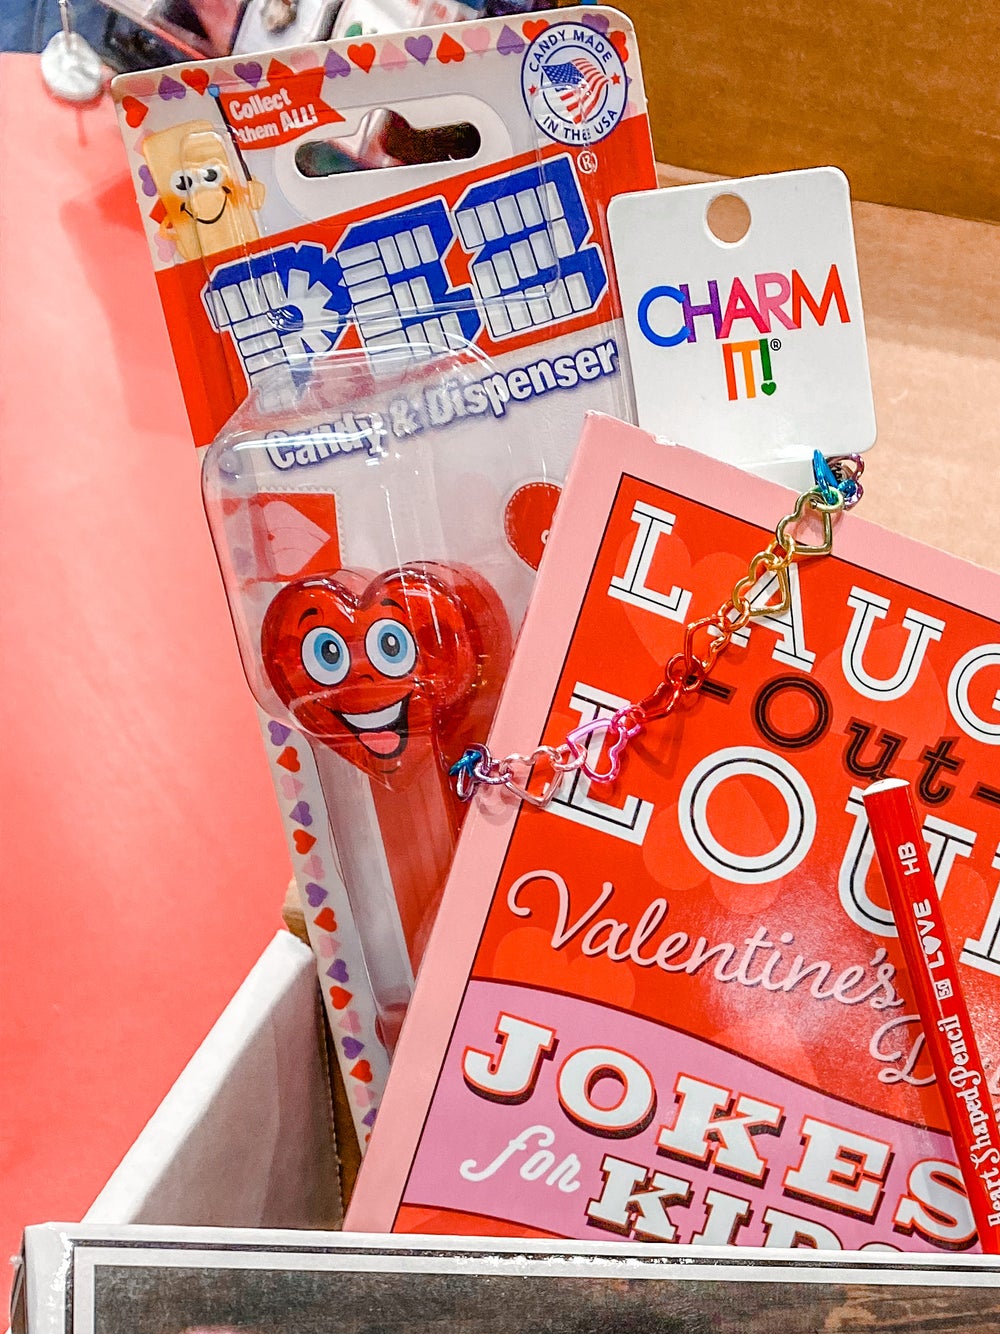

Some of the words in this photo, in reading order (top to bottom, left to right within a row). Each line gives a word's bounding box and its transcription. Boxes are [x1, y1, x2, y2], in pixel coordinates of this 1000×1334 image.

[529, 29, 566, 72] CANDY
[573, 29, 612, 63] MADE
[229, 87, 292, 120] Collect
[239, 122, 280, 143] them
[280, 103, 318, 132] ALL!
[543, 116, 559, 134] IN
[593, 109, 618, 134] USA
[203, 153, 608, 412] PEZ
[638, 264, 851, 347] CHARM
[266, 412, 384, 470] Candy
[389, 399, 421, 437] &
[423, 340, 618, 425] Dispenser
[722, 338, 777, 401] IT!
[897, 841, 921, 876] HB
[507, 869, 904, 1009] Valentine's
[937, 1014, 982, 1090] Pencil
[461, 1012, 978, 1250] JOKES
[957, 1084, 1000, 1170] Shaped
[460, 1124, 583, 1194] for
[584, 1153, 904, 1251] KID
